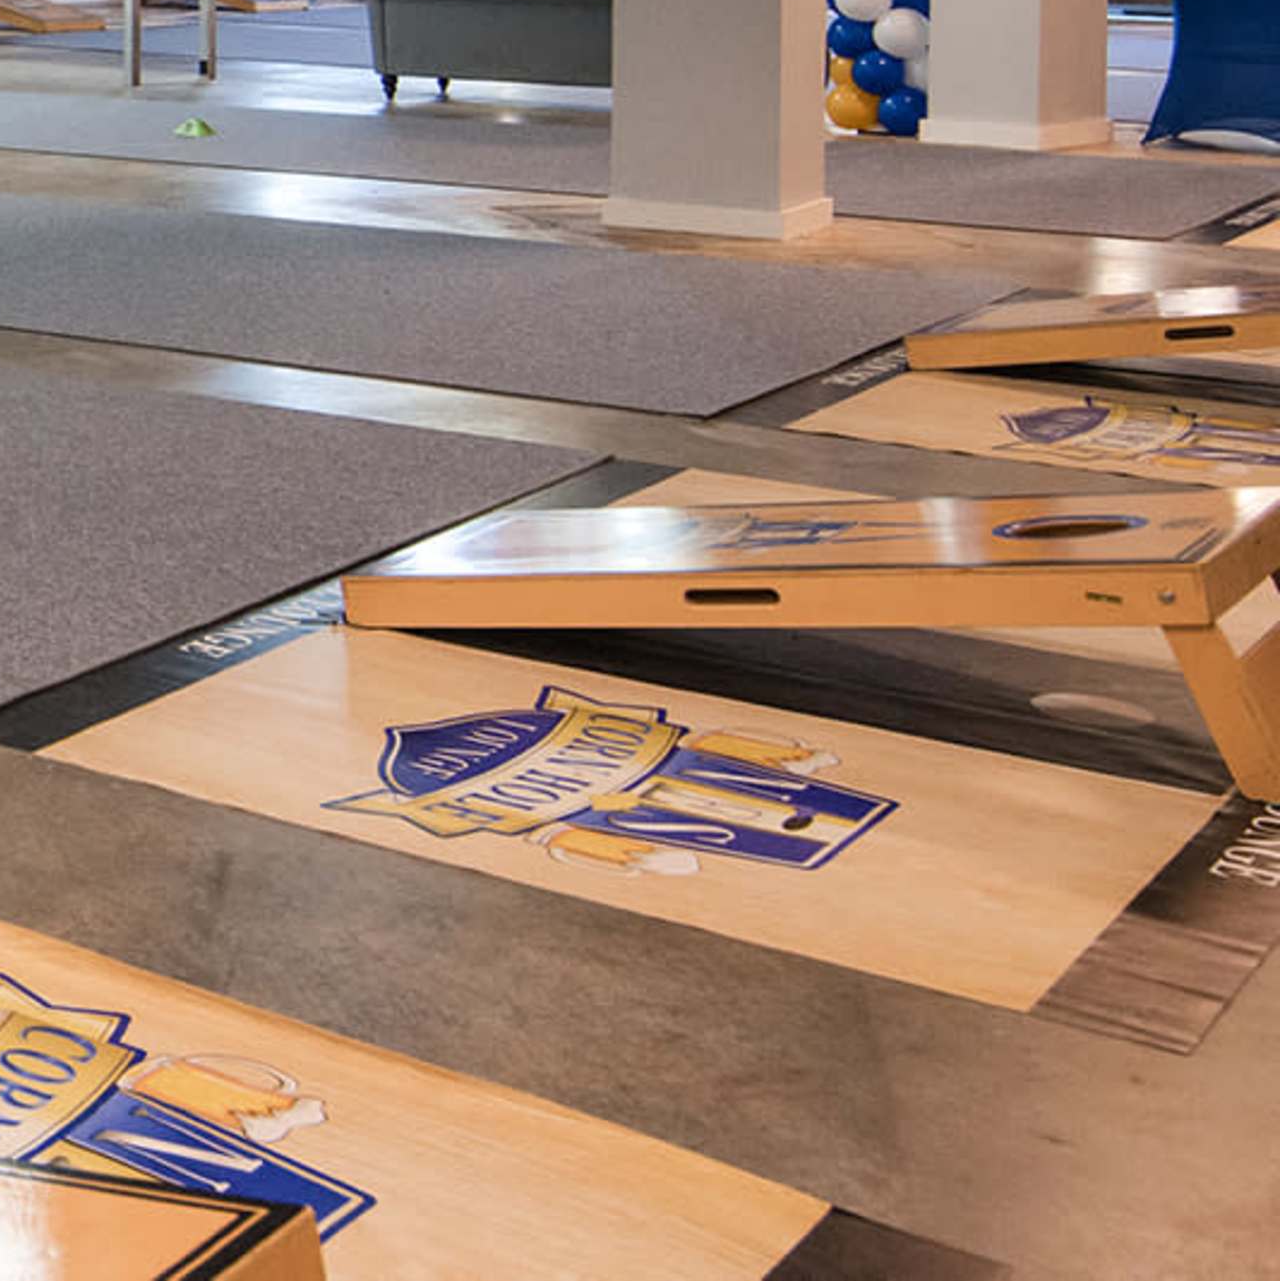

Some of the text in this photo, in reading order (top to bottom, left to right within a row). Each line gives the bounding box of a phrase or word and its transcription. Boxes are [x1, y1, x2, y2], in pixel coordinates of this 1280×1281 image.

[408, 717, 537, 780] LOUNGE
[422, 712, 652, 822] CORN HOLE
